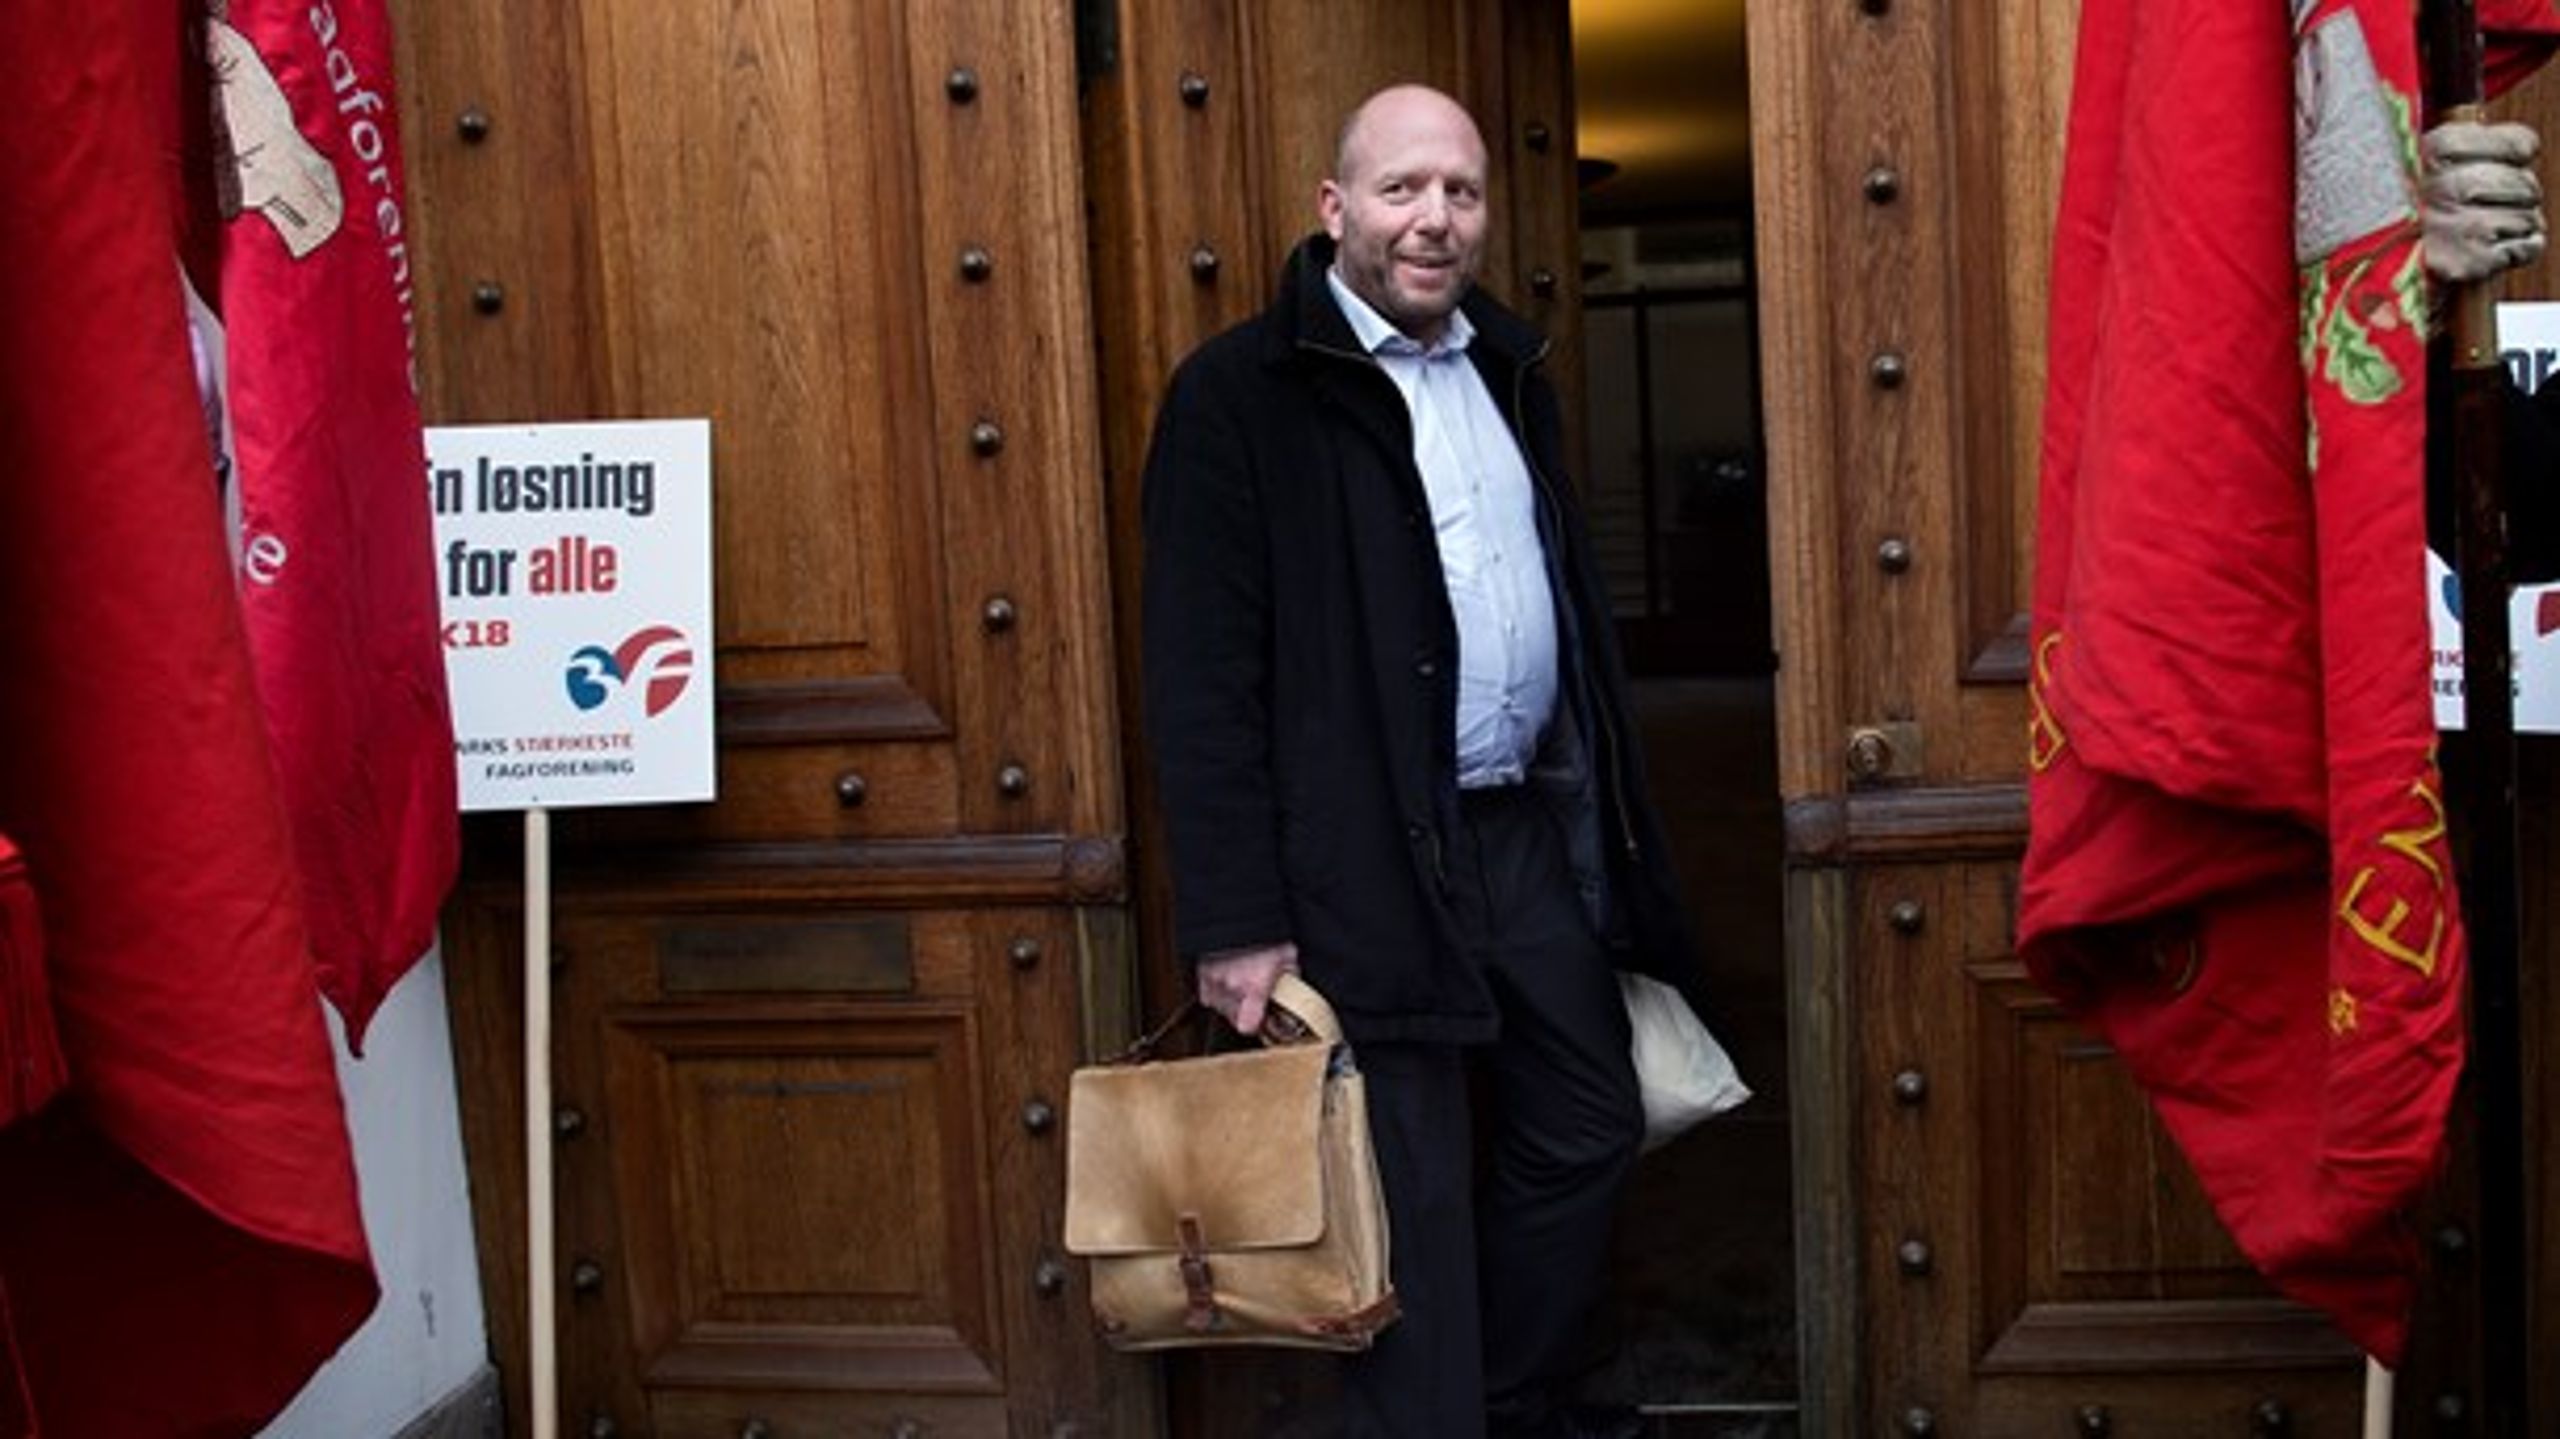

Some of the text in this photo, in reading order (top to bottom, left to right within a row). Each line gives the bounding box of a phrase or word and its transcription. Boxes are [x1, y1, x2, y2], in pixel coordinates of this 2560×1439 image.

[425, 453, 656, 517] n løsning
[446, 536, 618, 597] for alle
[485, 758, 635, 779] FAGFORENING
